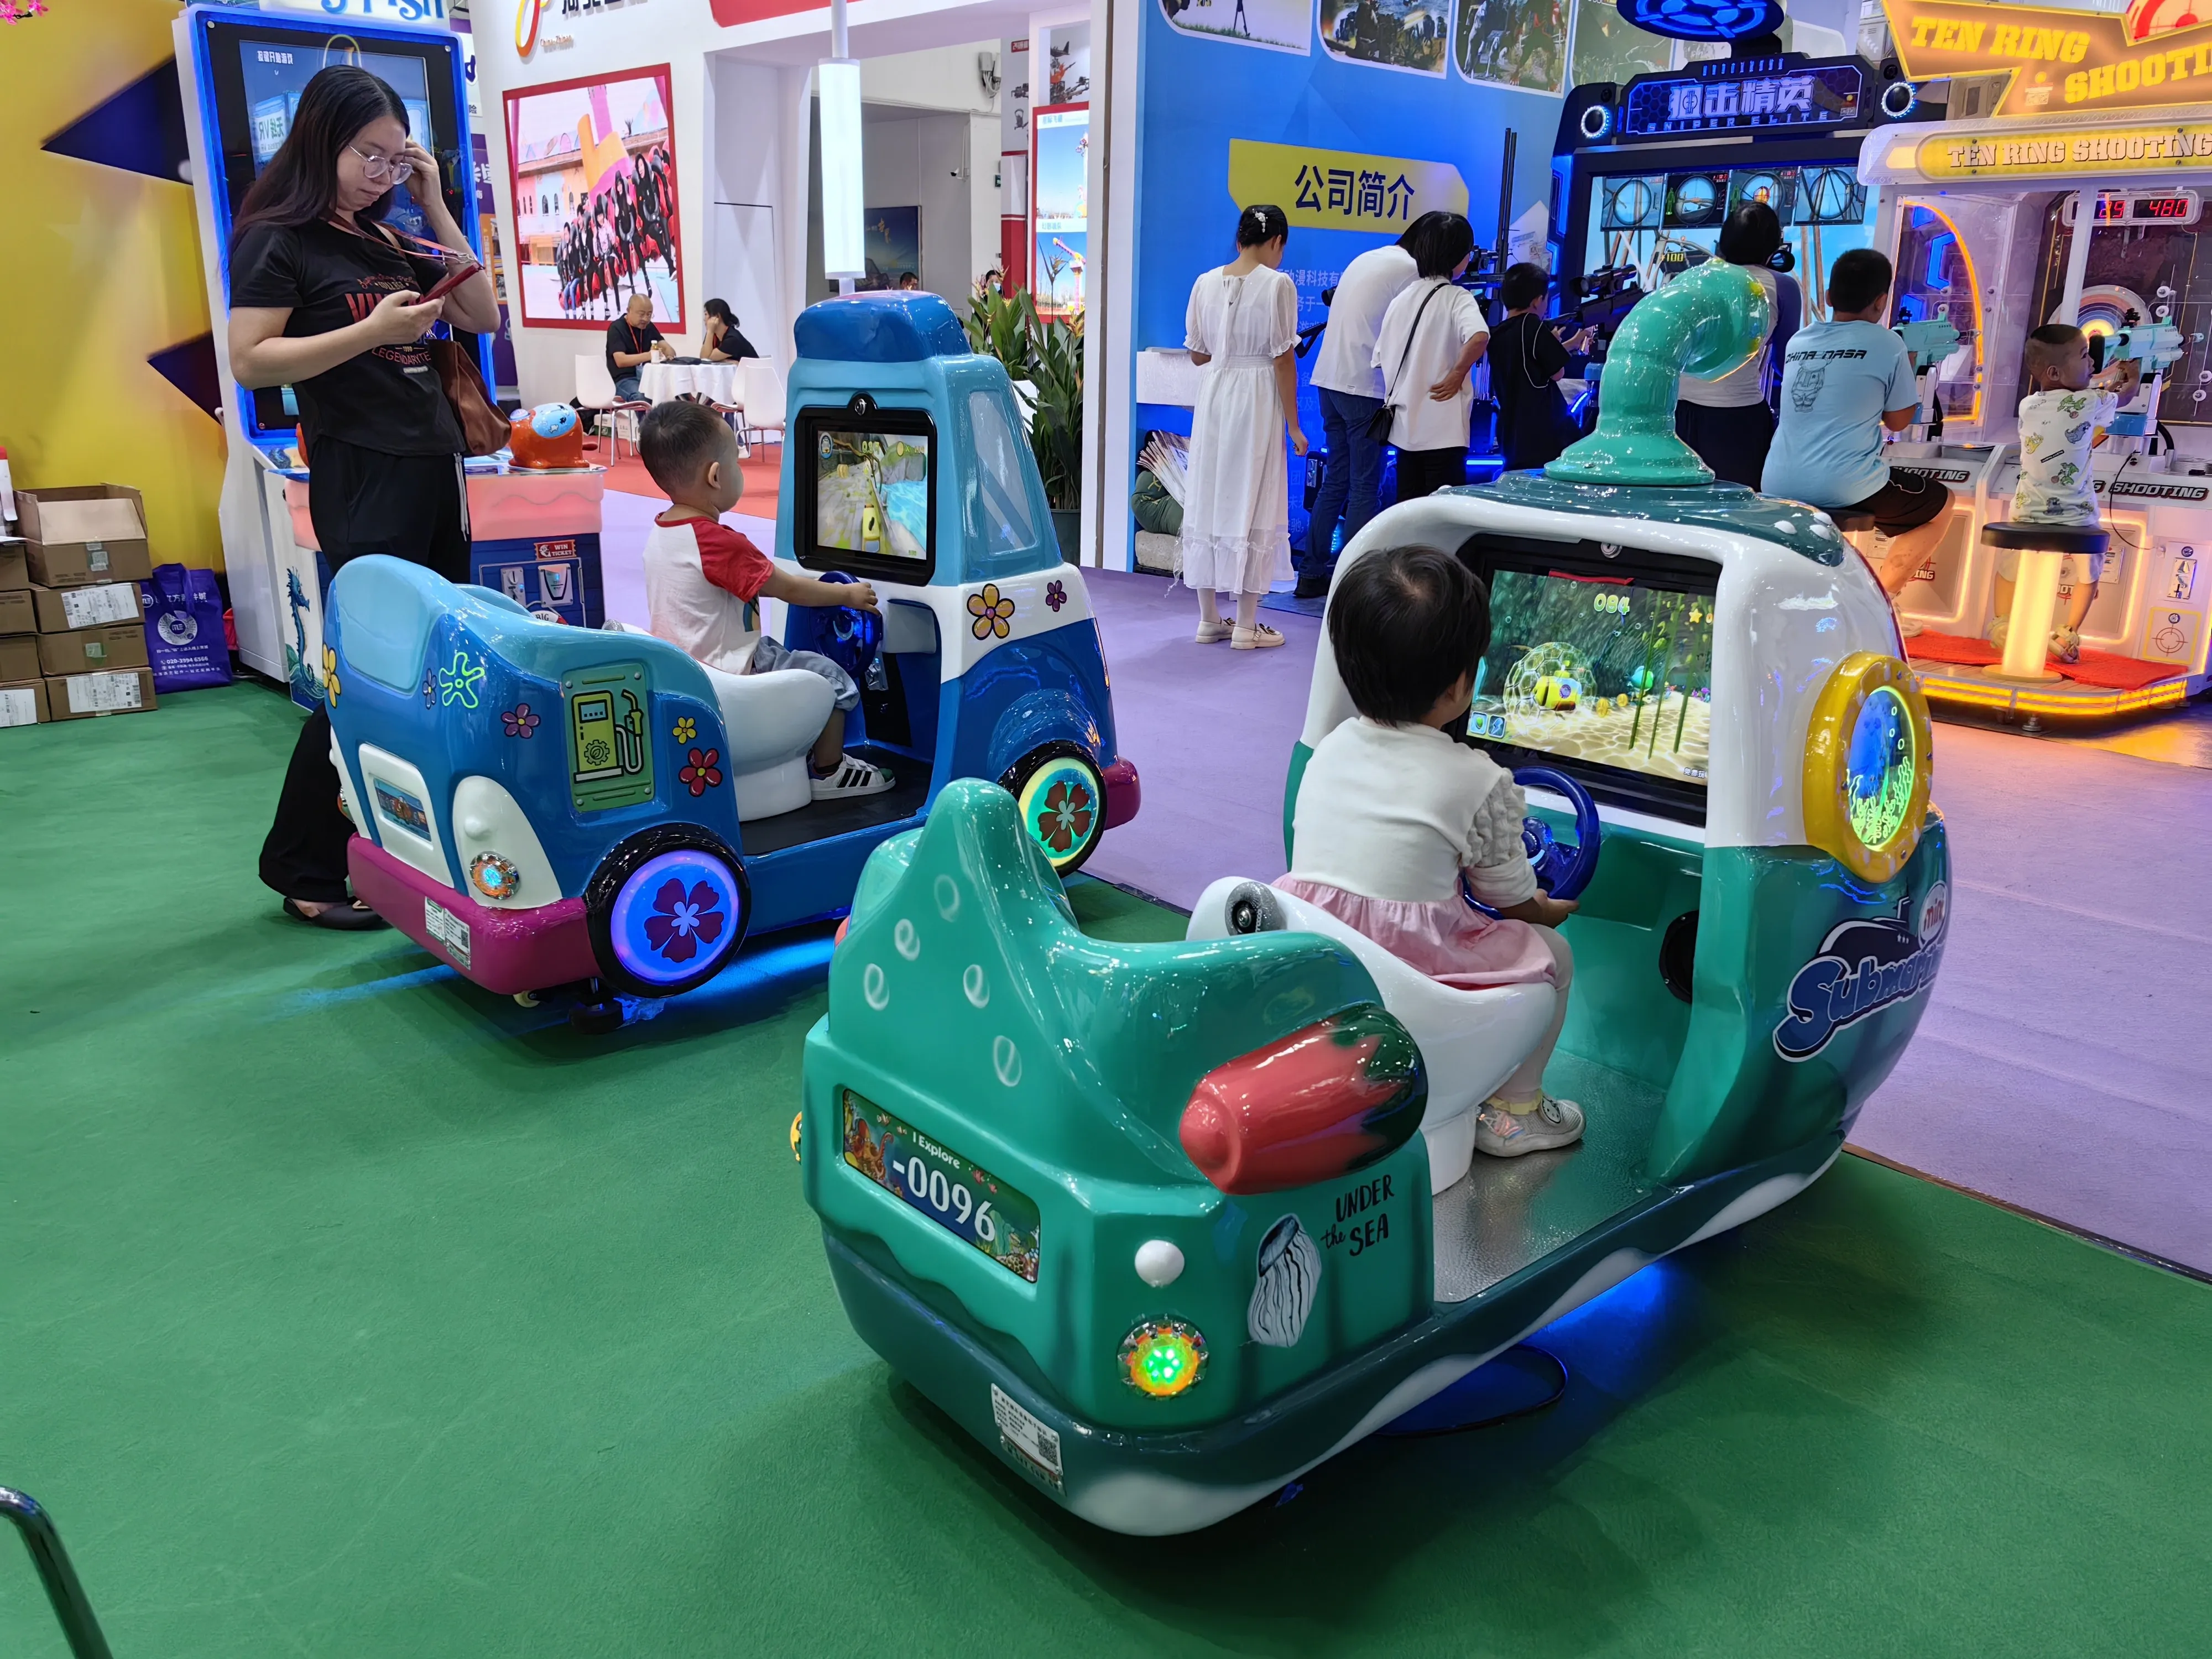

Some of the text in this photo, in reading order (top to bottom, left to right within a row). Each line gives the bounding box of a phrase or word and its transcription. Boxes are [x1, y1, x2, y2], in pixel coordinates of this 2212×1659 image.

[1911, 15, 2090, 63] TEN RING
[1668, 75, 1815, 121] 狙击精英
[1647, 111, 1829, 132] SNIPER ELITE
[1948, 133, 2212, 168] TEN RING SHOOTING
[1294, 165, 1415, 220] 公司简介
[2149, 199, 2189, 217] 480
[2110, 483, 2205, 498] SHOOTING
[1594, 593, 1630, 615] 084
[1683, 767, 1705, 779] 免费玩
[912, 1131, 961, 1170] I Explore
[892, 1156, 996, 1242] -0096
[1335, 1175, 1395, 1223] UNDER
[1319, 1213, 1390, 1257] the SEA
